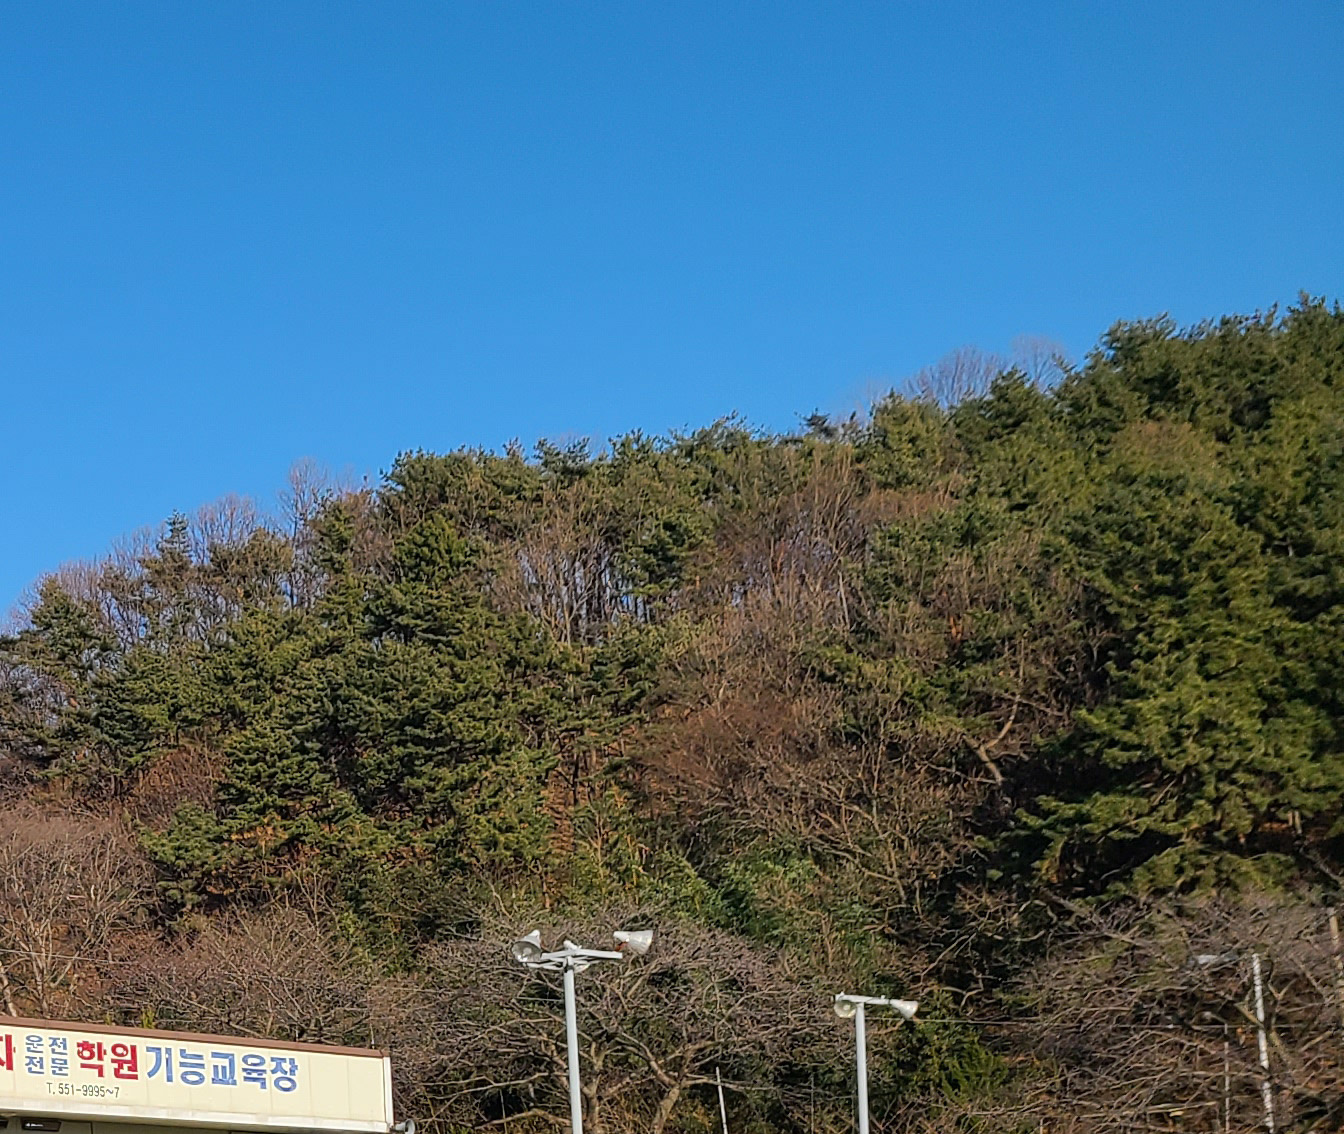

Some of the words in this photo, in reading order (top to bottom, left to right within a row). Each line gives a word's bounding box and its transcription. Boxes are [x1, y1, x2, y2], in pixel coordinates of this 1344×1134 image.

[25, 1034, 68, 1056] 운전
[77, 1040, 139, 1080] 학원
[24, 1055, 69, 1076] 전문
[146, 1046, 298, 1092] 기능교육장
